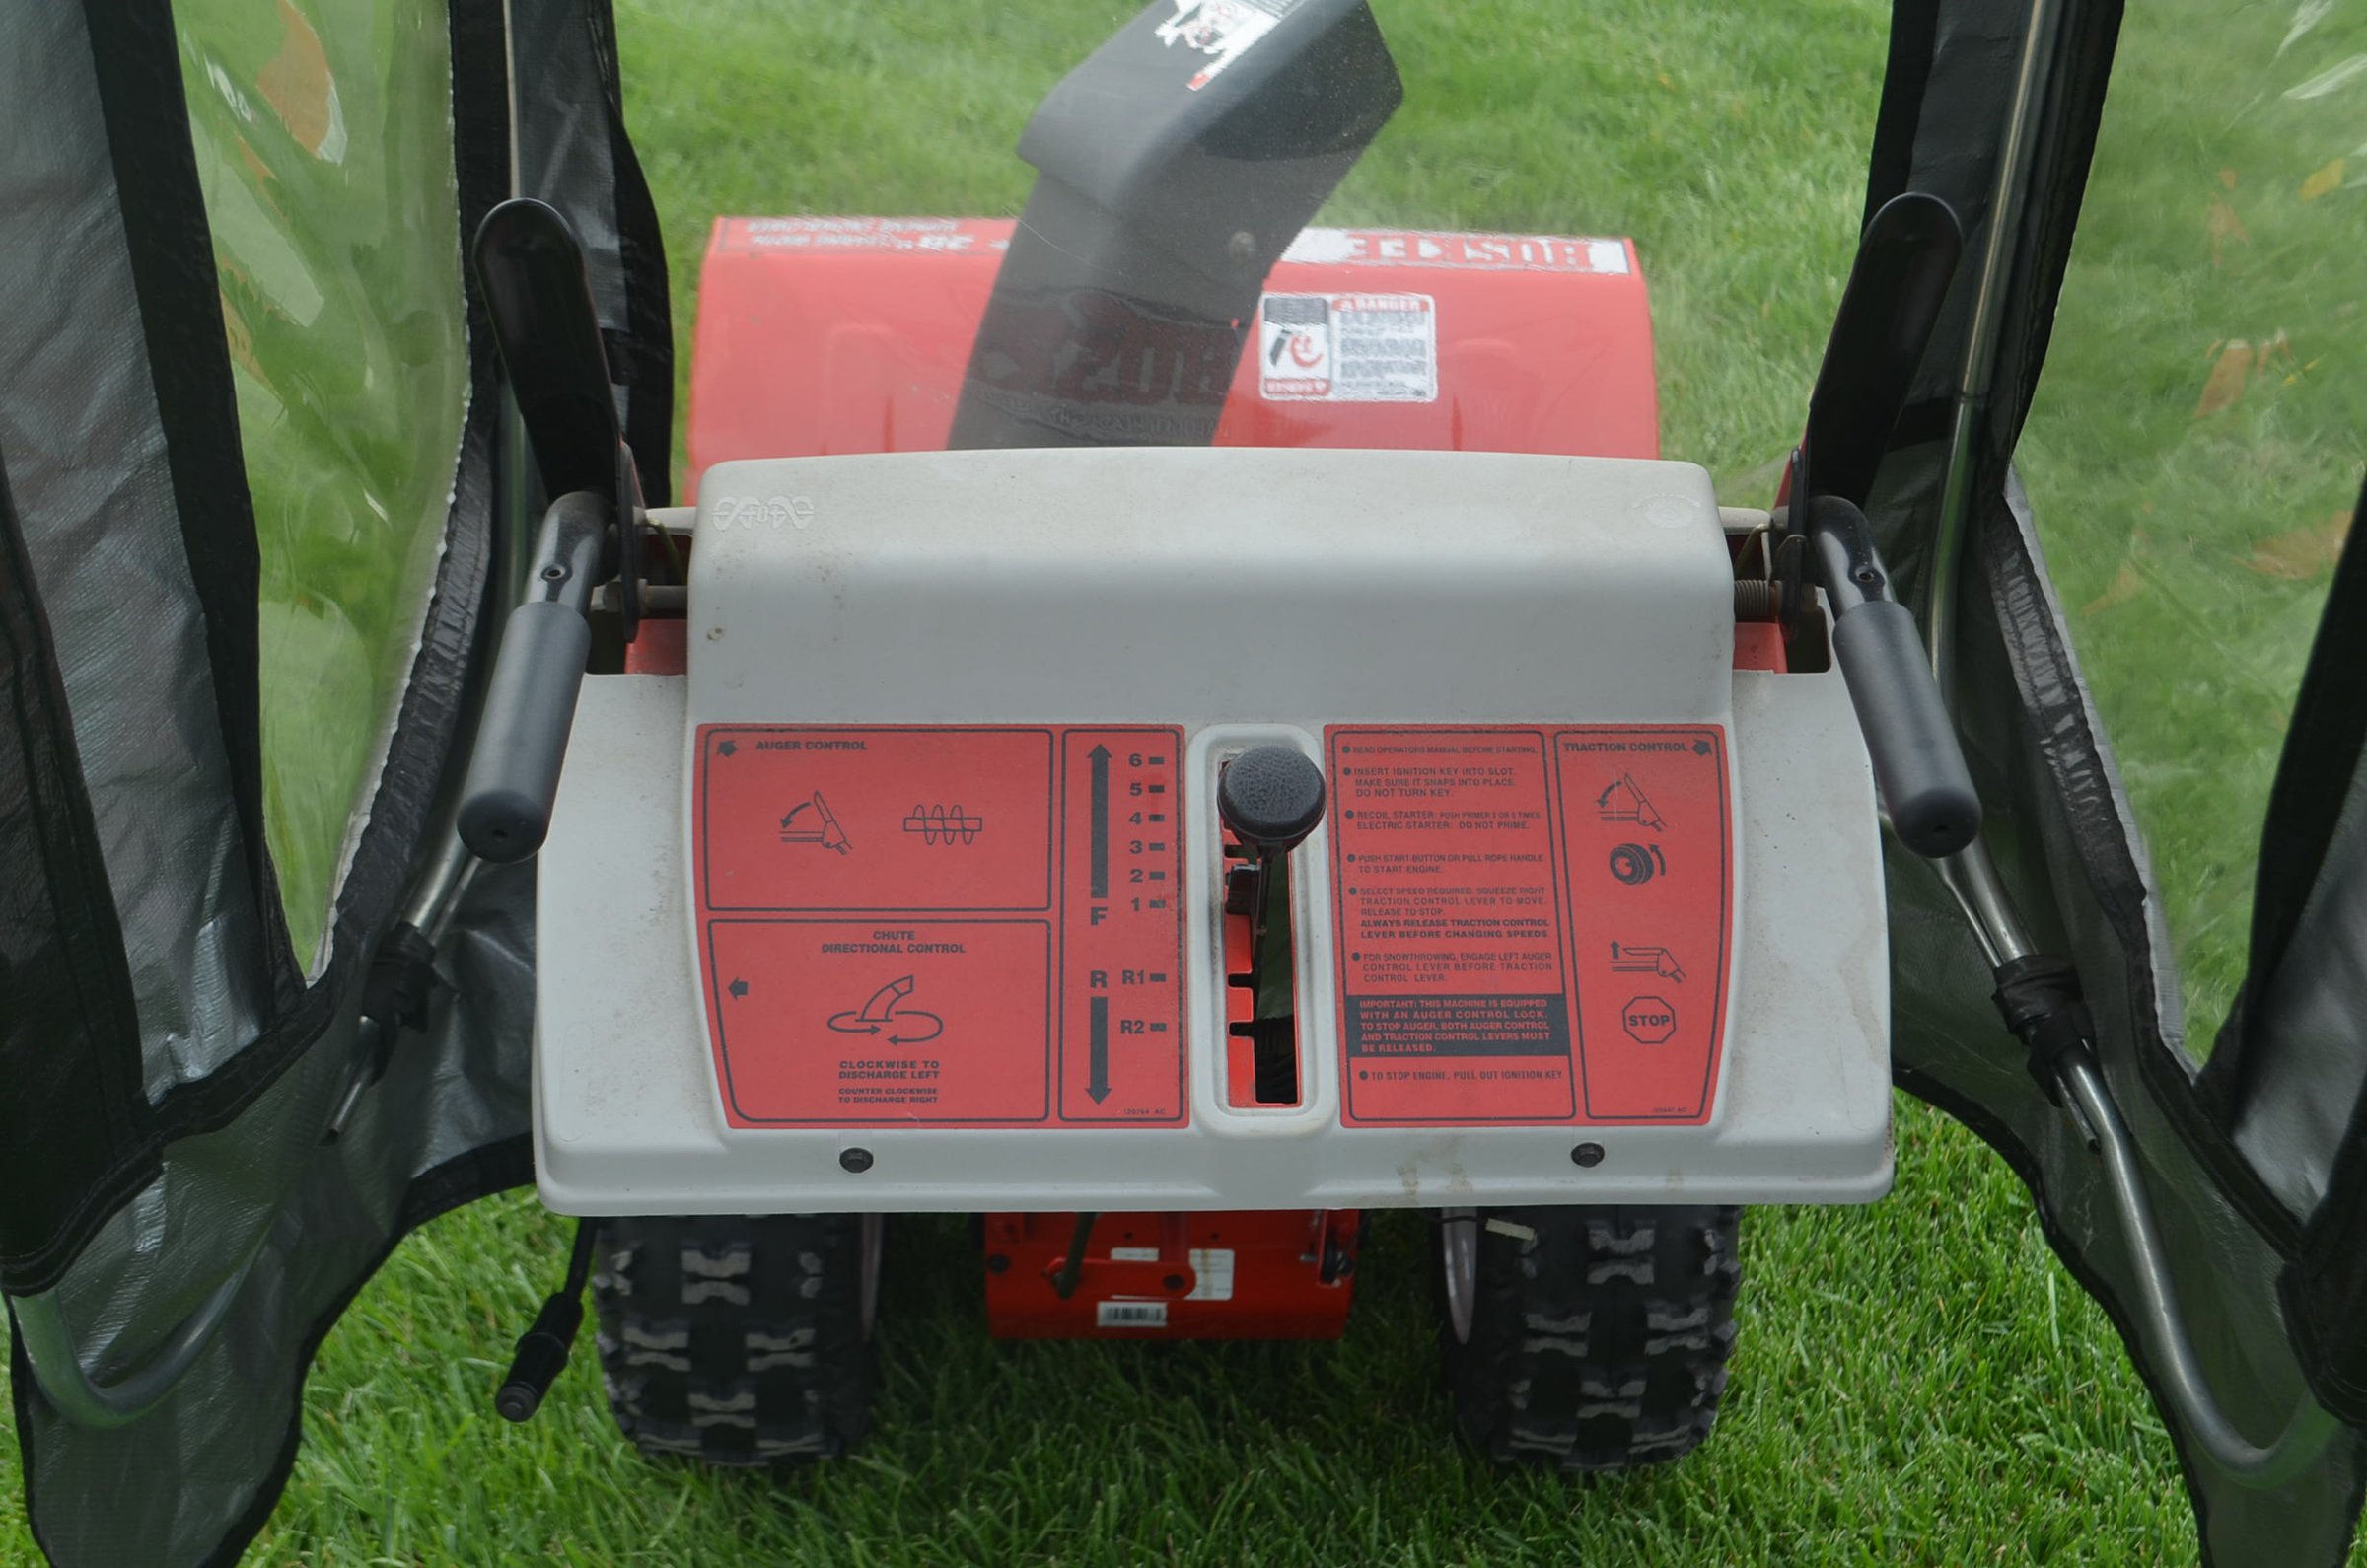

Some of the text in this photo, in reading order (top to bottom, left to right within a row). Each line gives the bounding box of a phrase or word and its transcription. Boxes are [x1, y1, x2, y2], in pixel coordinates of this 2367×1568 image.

[1345, 233, 1593, 269] HUSKEE
[755, 741, 867, 750] AUGER CONTROL
[1564, 742, 1688, 751] TRACTION CONTROL
[1128, 753, 1143, 767] 6
[1129, 782, 1143, 796] 5
[1128, 812, 1142, 824] 4
[1129, 840, 1142, 854] 3
[1130, 869, 1143, 883] 2
[1130, 898, 1140, 912] 1
[1090, 907, 1108, 925] F
[874, 931, 915, 940] CHUTE
[822, 944, 966, 953] DIRECTIONAL CONTROL
[1090, 970, 1108, 988] R
[1122, 970, 1145, 985] R1
[1120, 1020, 1144, 1034] R2
[1360, 1022, 1374, 1031] TO
[1376, 1022, 1401, 1031] STOP
[1441, 1022, 1468, 1031] BOTH
[1470, 1022, 1503, 1031] AUGER
[1504, 1022, 1549, 1031] CONTROL
[1629, 1014, 1670, 1027] STOP
[840, 1060, 940, 1069] CLOCKWISE TO
[1371, 1071, 1384, 1080] TO
[1386, 1071, 1410, 1080] STOP
[1453, 1071, 1476, 1080] PULL
[1479, 1071, 1498, 1080] OUT
[1501, 1071, 1542, 1080] IGNITION
